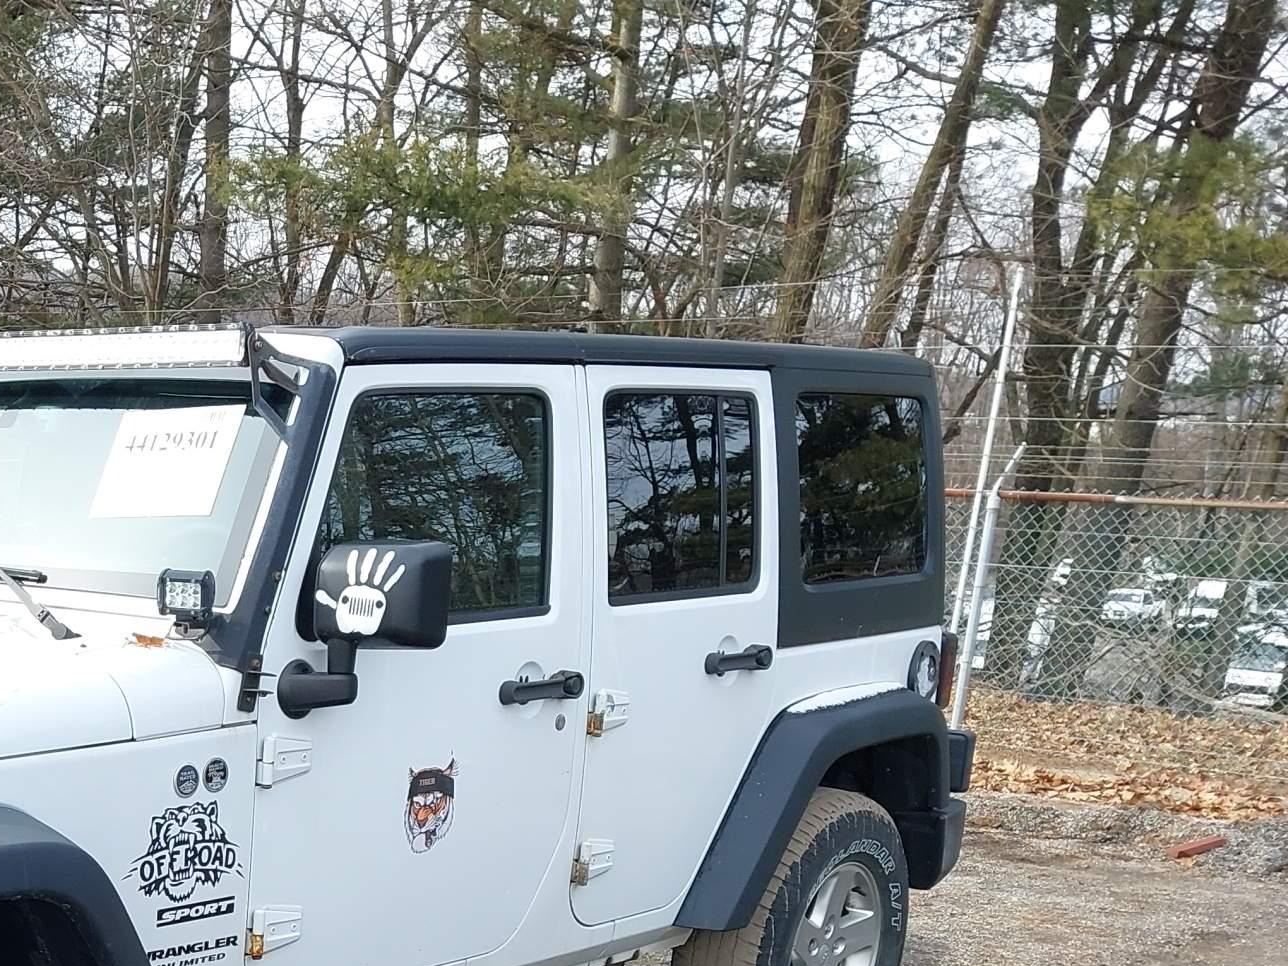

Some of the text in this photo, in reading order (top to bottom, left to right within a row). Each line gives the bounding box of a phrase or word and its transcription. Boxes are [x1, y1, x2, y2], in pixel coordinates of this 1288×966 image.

[125, 430, 218, 452] 44129301
[183, 844, 236, 870] ROAD
[161, 900, 230, 921] SPORT
